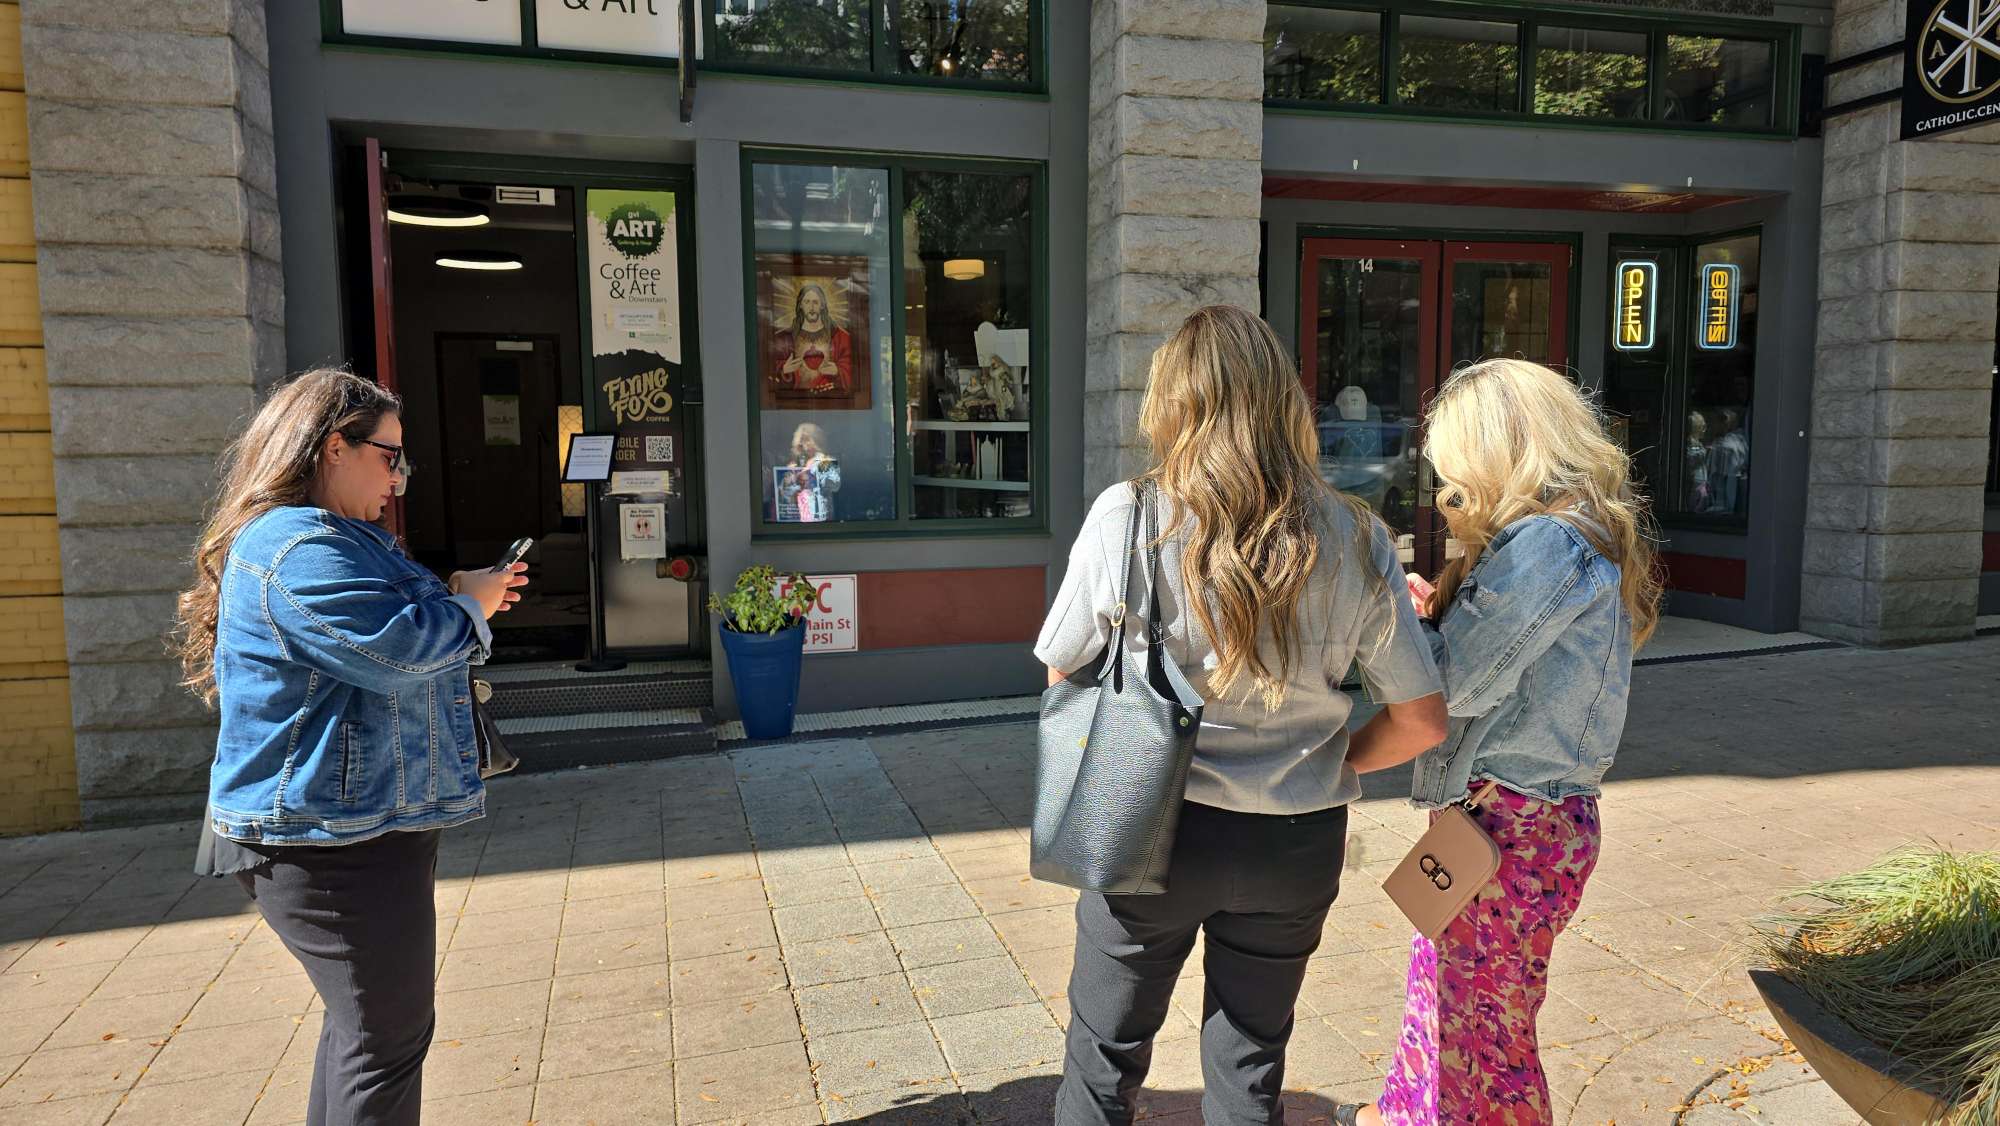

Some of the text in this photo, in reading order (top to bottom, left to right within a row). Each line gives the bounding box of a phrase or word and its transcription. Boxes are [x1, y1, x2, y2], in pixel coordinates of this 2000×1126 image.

[613, 219, 656, 238] ART
[600, 263, 661, 281] Coffee
[1358, 258, 1374, 273] 14
[609, 279, 657, 299] & Art
[628, 296, 668, 304] Downstairs
[1626, 268, 1645, 343] OPEN
[602, 367, 669, 406] FLYING
[611, 388, 673, 427] FOX
[617, 436, 640, 449] BILE
[780, 582, 832, 614] FC
[837, 618, 851, 630] St
[812, 633, 833, 645] PSI
